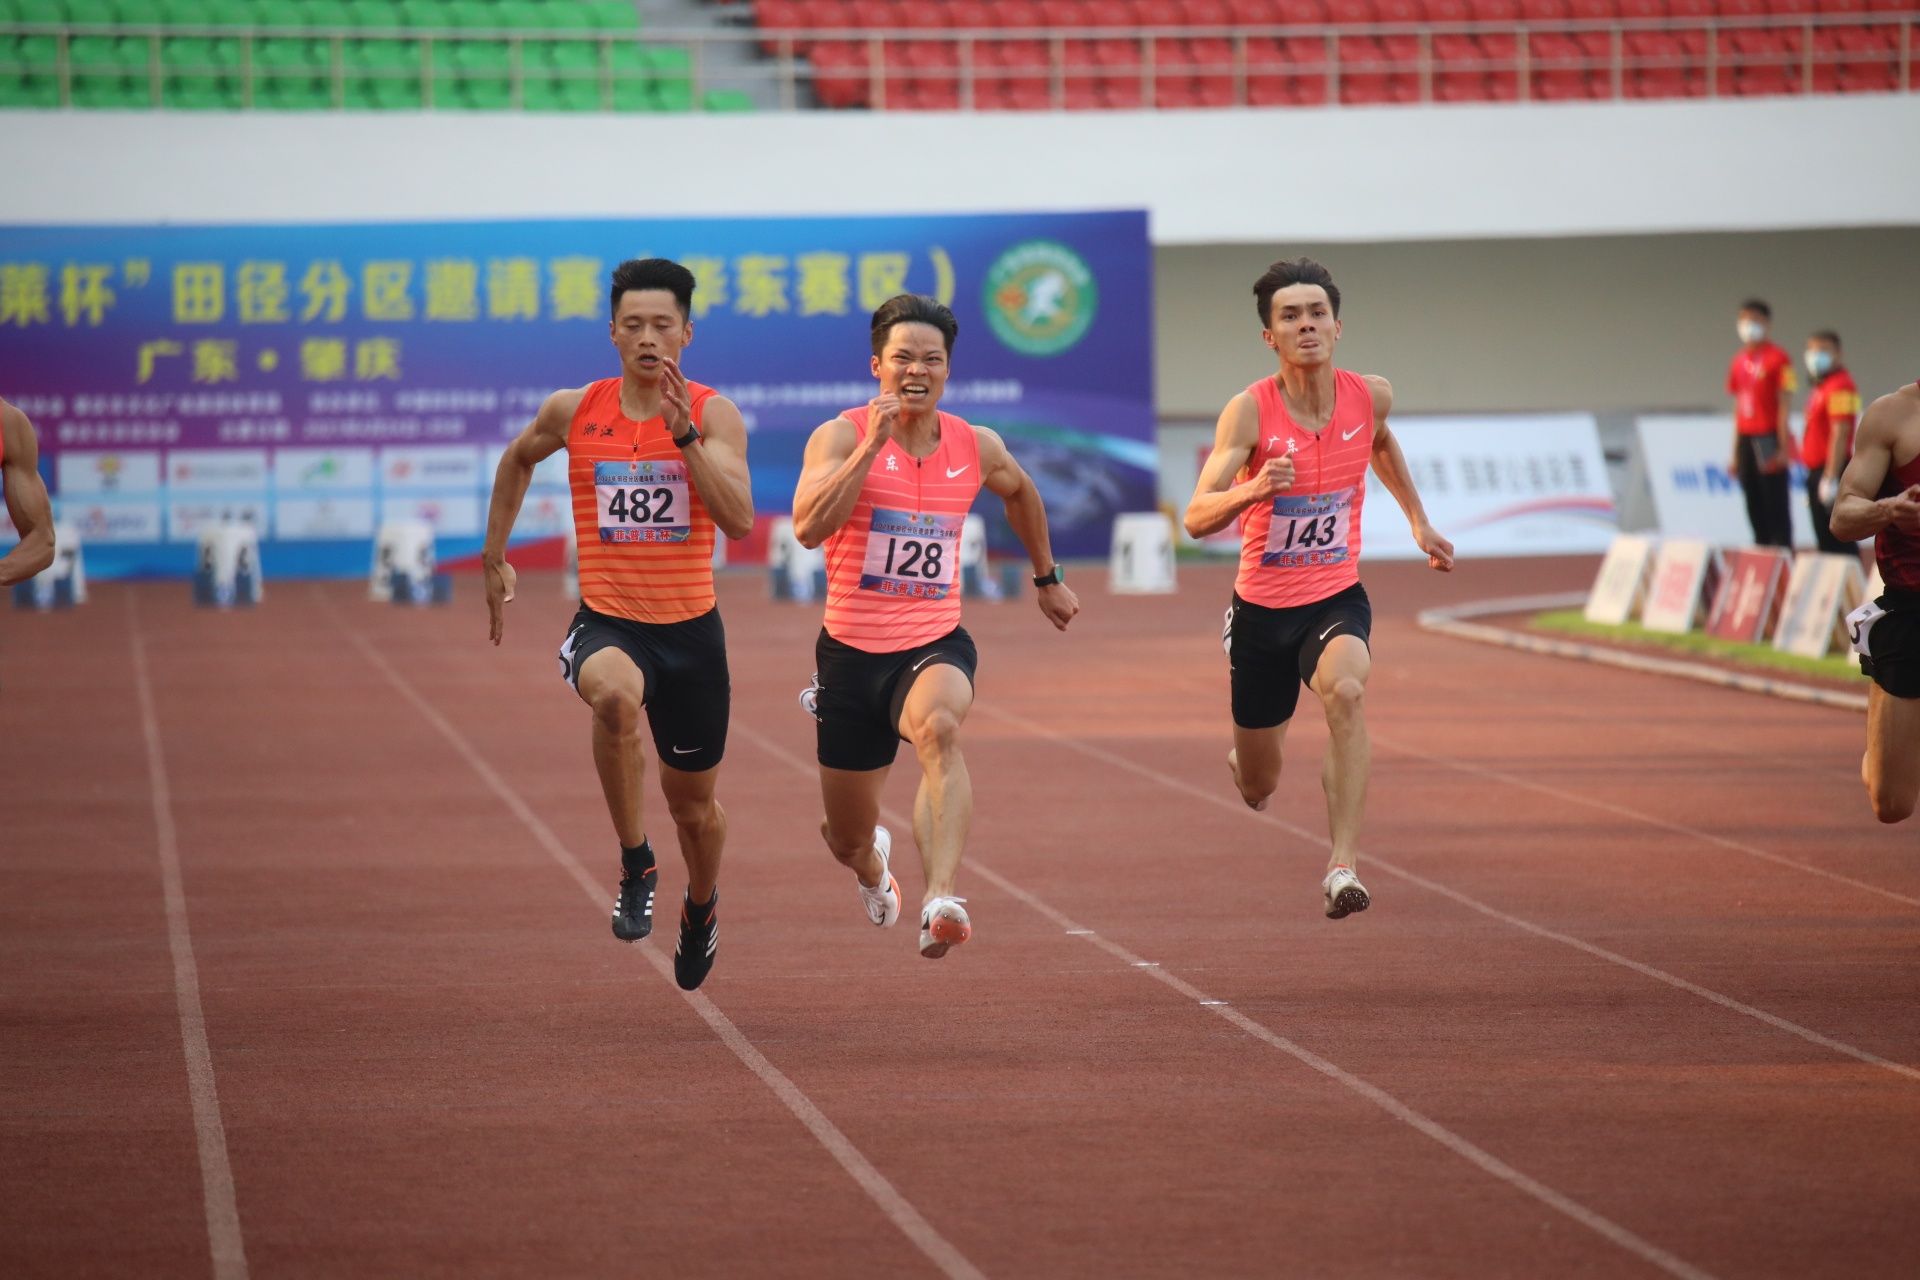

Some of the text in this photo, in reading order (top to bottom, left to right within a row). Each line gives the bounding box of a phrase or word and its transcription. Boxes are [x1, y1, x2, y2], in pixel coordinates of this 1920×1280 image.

[1267, 435, 1299, 453] 广东
[608, 488, 674, 523] 482
[614, 530, 672, 541] 菲普莱杯
[1284, 514, 1337, 550] 143
[884, 538, 943, 579] 128
[1280, 551, 1334, 566] 菲普莱杯
[881, 580, 938, 598] 菲普莱杯
